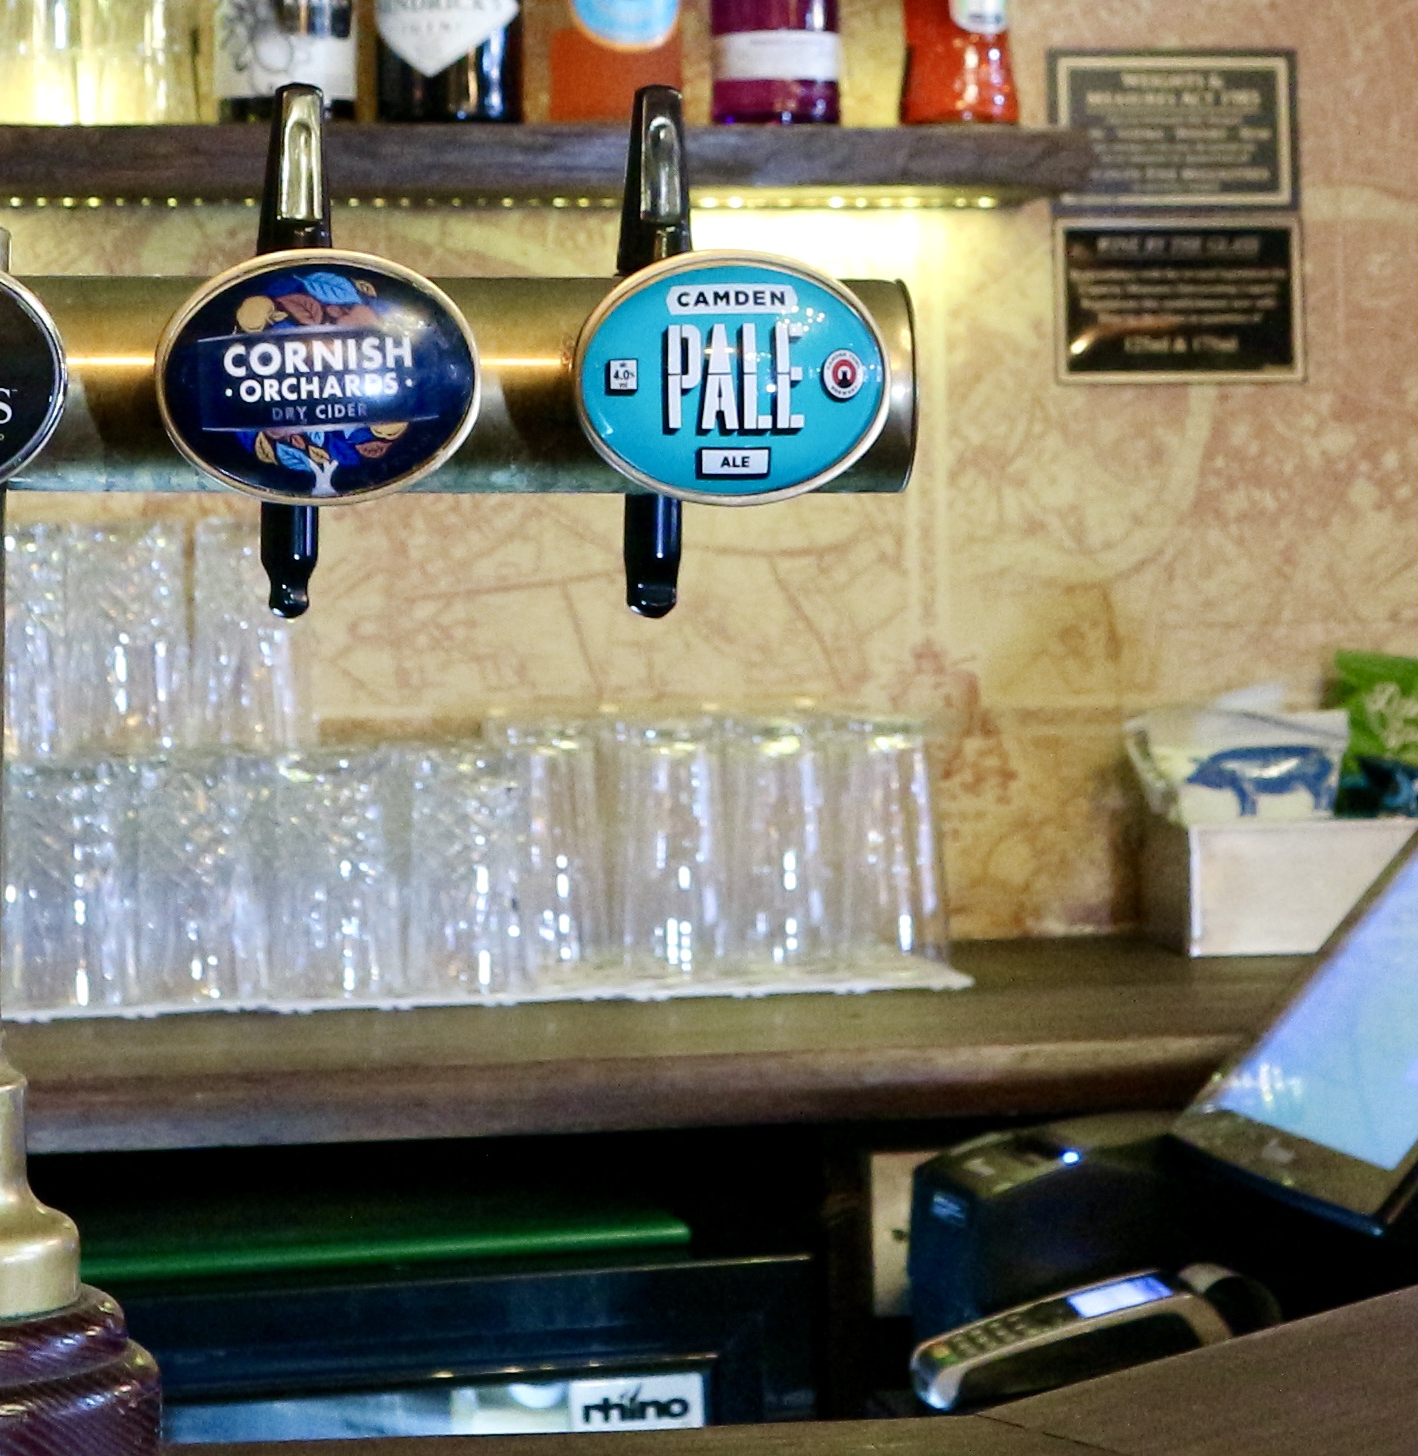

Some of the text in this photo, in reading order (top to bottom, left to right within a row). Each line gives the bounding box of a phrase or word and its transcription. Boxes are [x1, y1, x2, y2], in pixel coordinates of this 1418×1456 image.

[676, 290, 787, 307] CAMDEN
[223, 337, 413, 378] CORNISH
[239, 372, 399, 404] ORCHARDS
[667, 321, 806, 431] PALE
[271, 401, 368, 422] DRY CIDER
[720, 455, 751, 469] ALE
[583, 1384, 689, 1423] rhino
